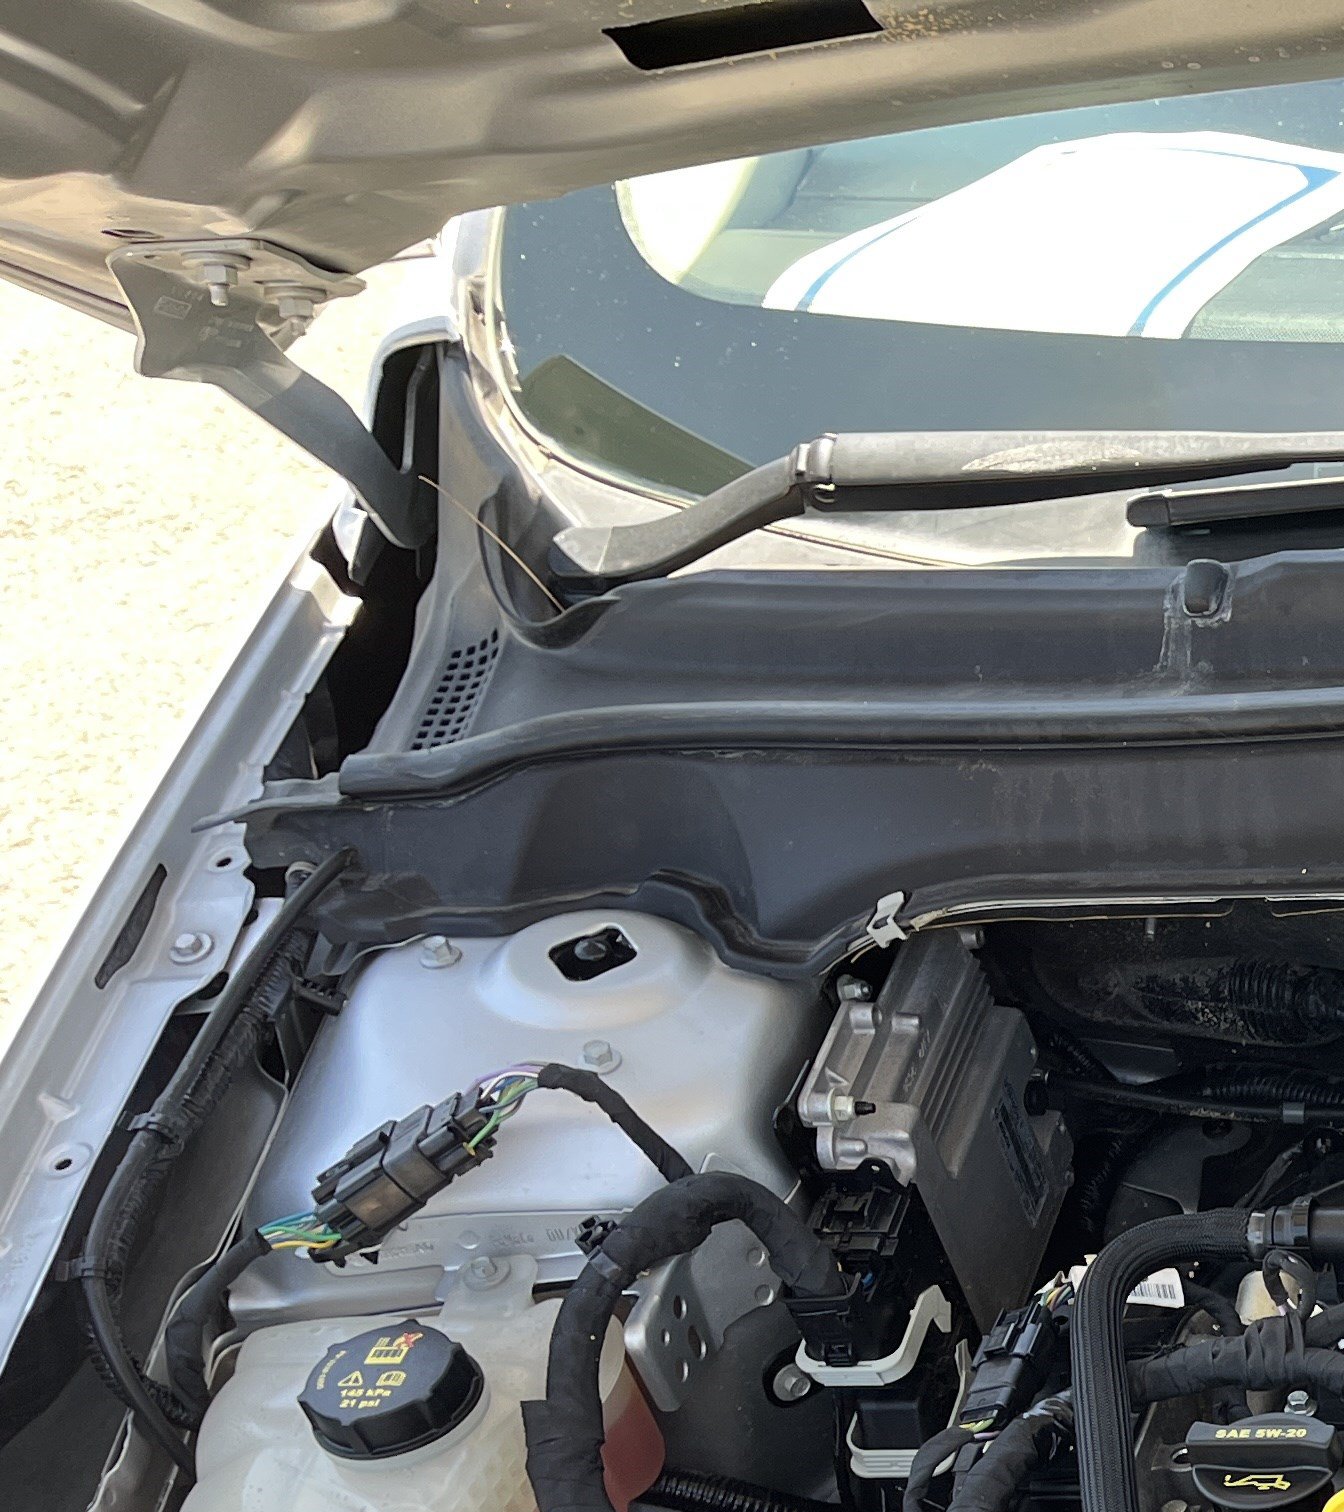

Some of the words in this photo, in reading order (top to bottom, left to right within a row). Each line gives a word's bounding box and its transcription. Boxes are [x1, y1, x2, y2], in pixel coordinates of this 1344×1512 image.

[339, 1399, 355, 1408] 21
[1215, 1429, 1251, 1438] SAE
[1255, 1428, 1307, 1438] 5W-20
